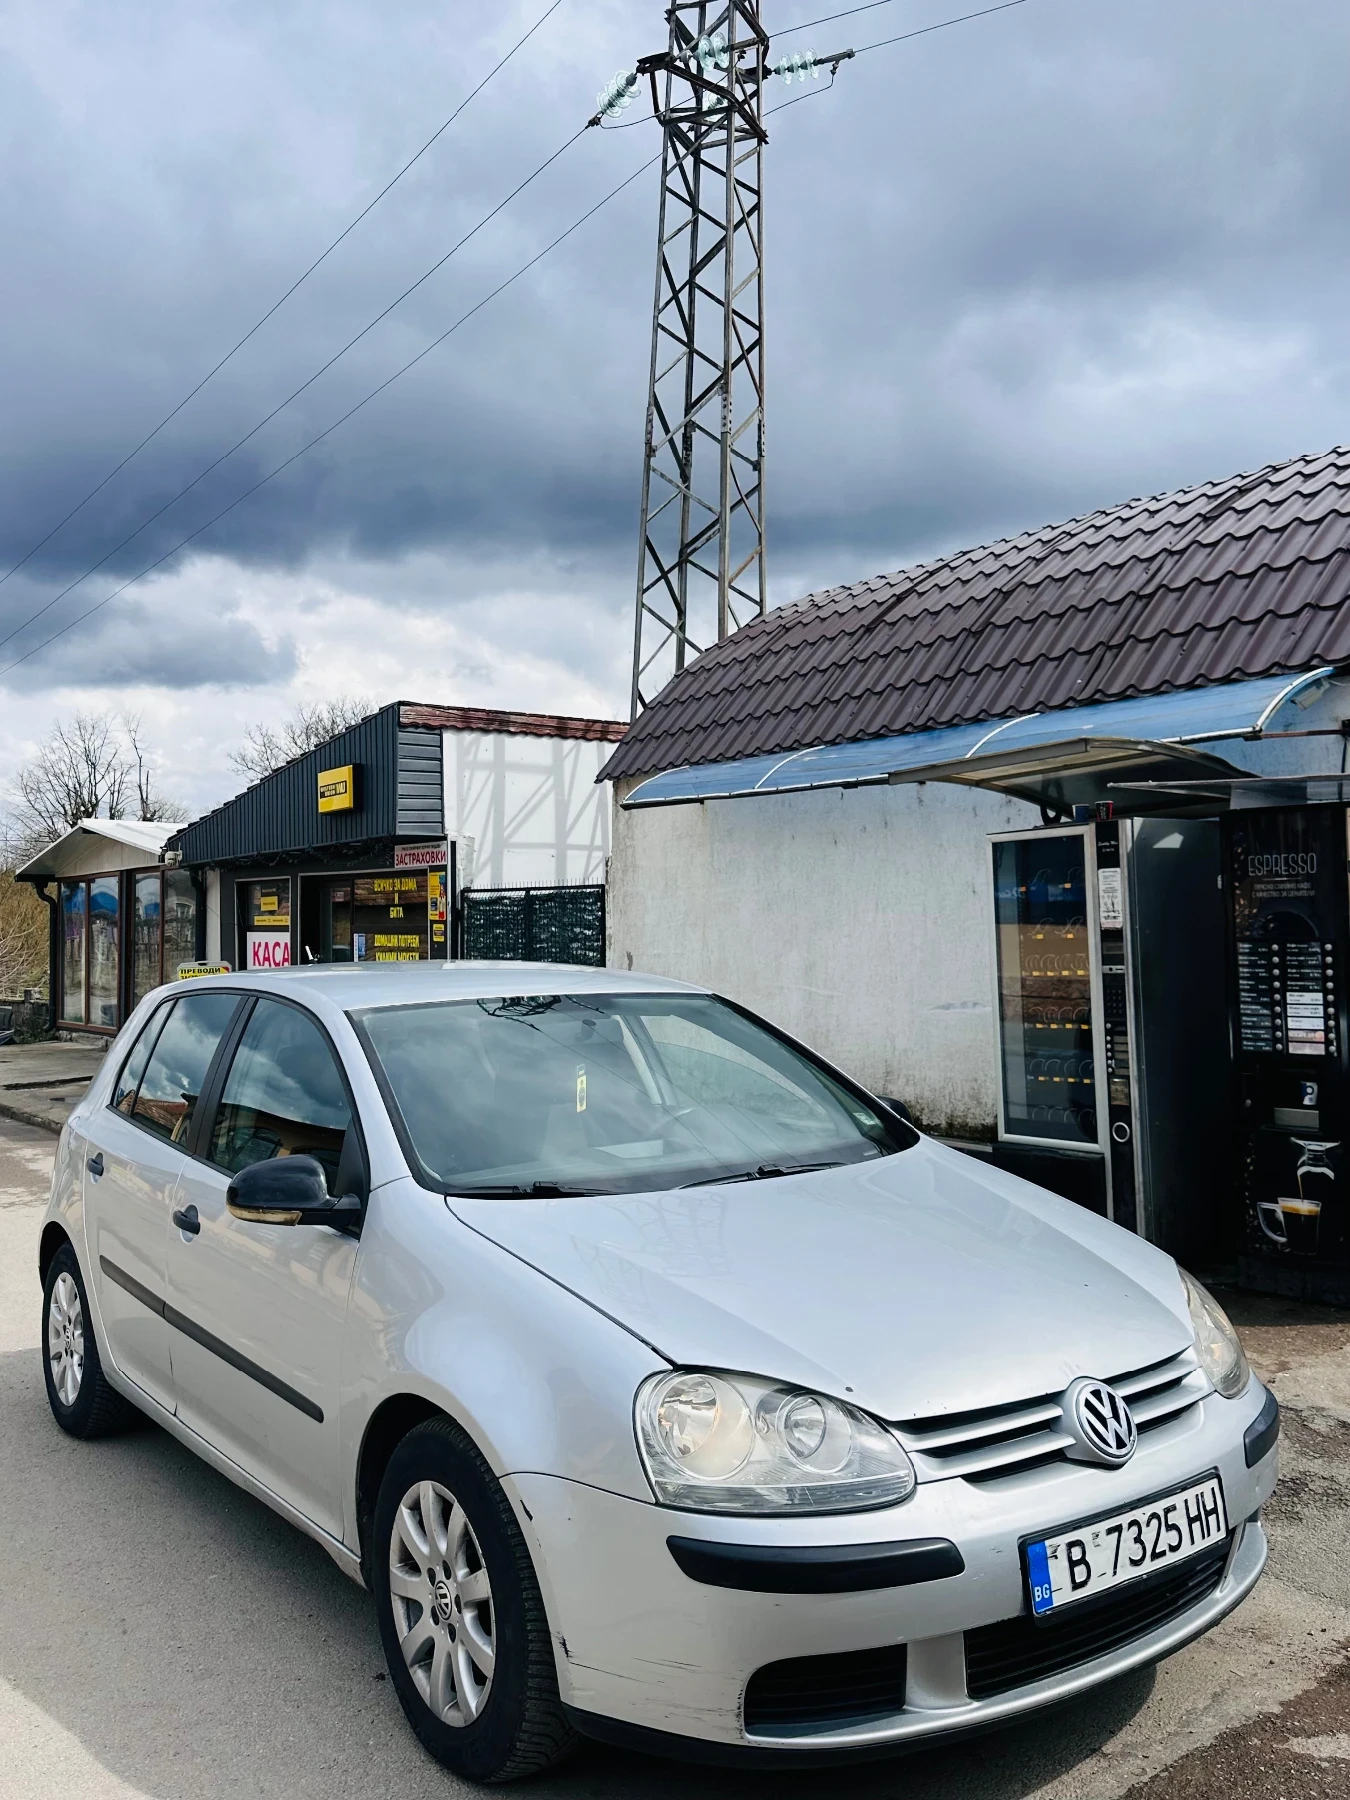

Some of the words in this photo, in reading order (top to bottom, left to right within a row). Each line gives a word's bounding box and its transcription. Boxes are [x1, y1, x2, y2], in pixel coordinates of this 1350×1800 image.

[395, 850, 447, 867] ЗАСТРАХОВКИ
[1248, 852, 1317, 876] ESPRESSO
[374, 879, 393, 892] ВСИЧКО
[394, 878, 401, 891] ЗА
[402, 878, 417, 891] ДОМА
[394, 893, 398, 904] И
[390, 907, 404, 918] БИТА
[253, 941, 291, 968] КАСА
[180, 967, 221, 975] ПРЕВОДИ
[1066, 1538, 1092, 1592] B
[1105, 1502, 1183, 1577] 7325
[1184, 1486, 1222, 1546] HH
[1034, 1583, 1051, 1602] BG
